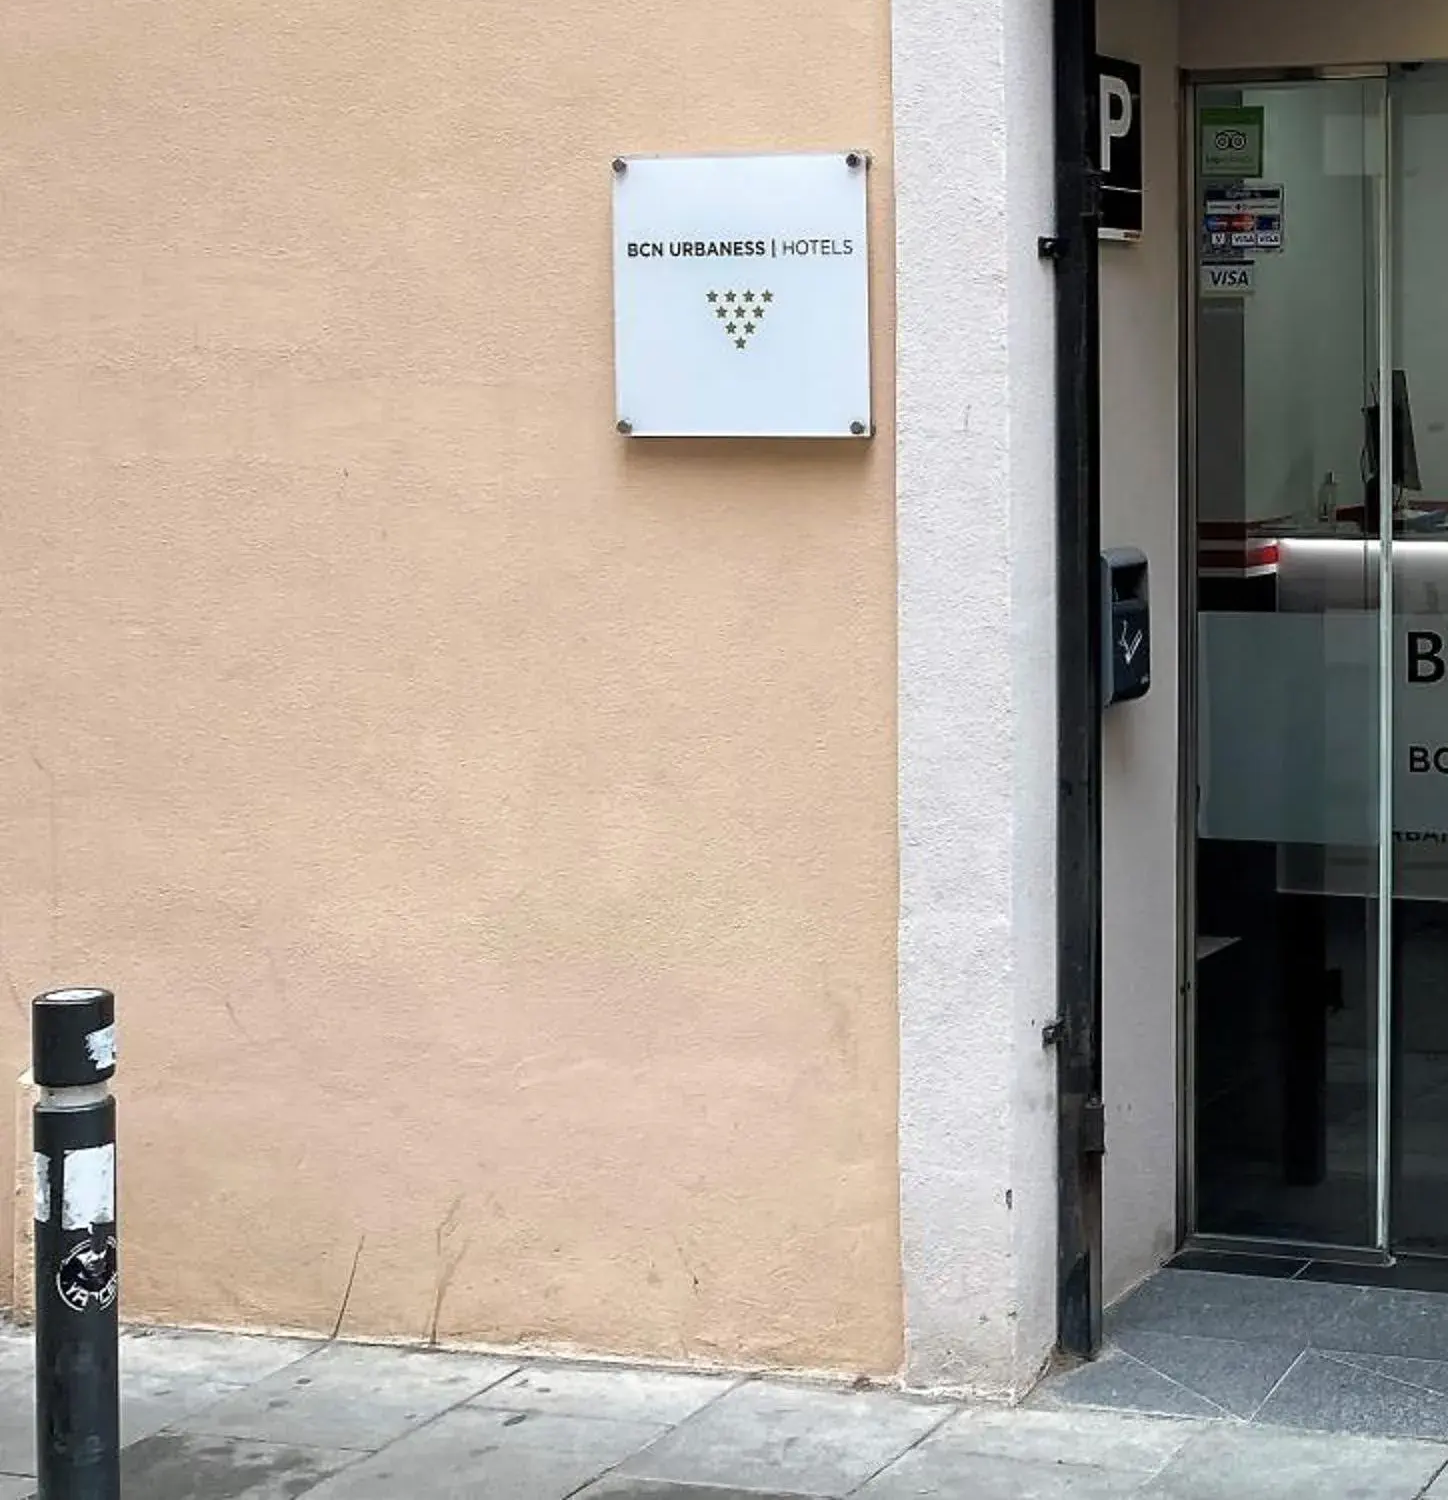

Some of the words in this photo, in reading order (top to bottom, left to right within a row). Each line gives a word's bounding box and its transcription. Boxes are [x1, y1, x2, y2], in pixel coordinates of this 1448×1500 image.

[1100, 73, 1132, 172] P
[627, 242, 664, 257] BCN
[669, 240, 765, 257] URBANESS
[782, 239, 853, 256] HOTELS
[1210, 270, 1249, 286] VISA
